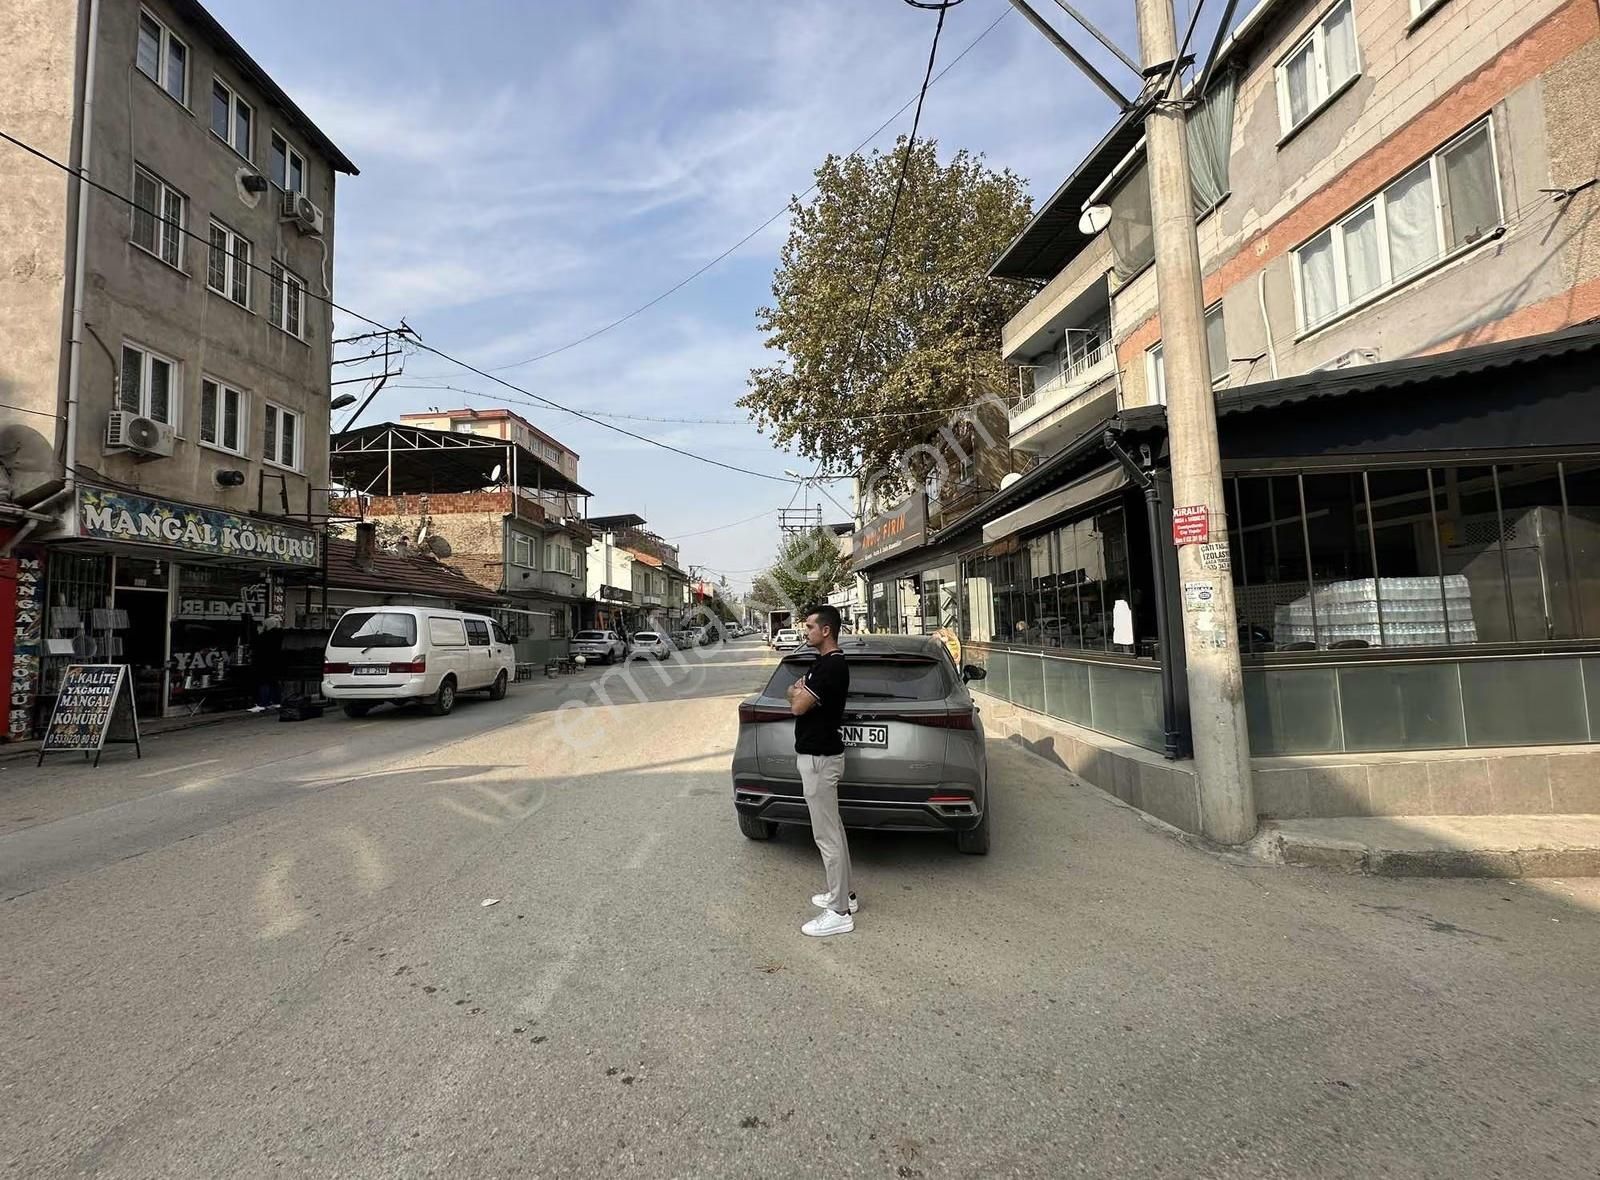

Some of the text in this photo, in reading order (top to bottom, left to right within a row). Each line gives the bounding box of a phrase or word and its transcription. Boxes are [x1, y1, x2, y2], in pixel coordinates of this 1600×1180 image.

[83, 503, 316, 559] MANGAL KÖMÜRÜ
[15, 557, 39, 638] MANGAL
[60, 695, 111, 707] MANGAL
[53, 709, 108, 725] KÖMÜRÜ
[869, 728, 885, 743] 50
